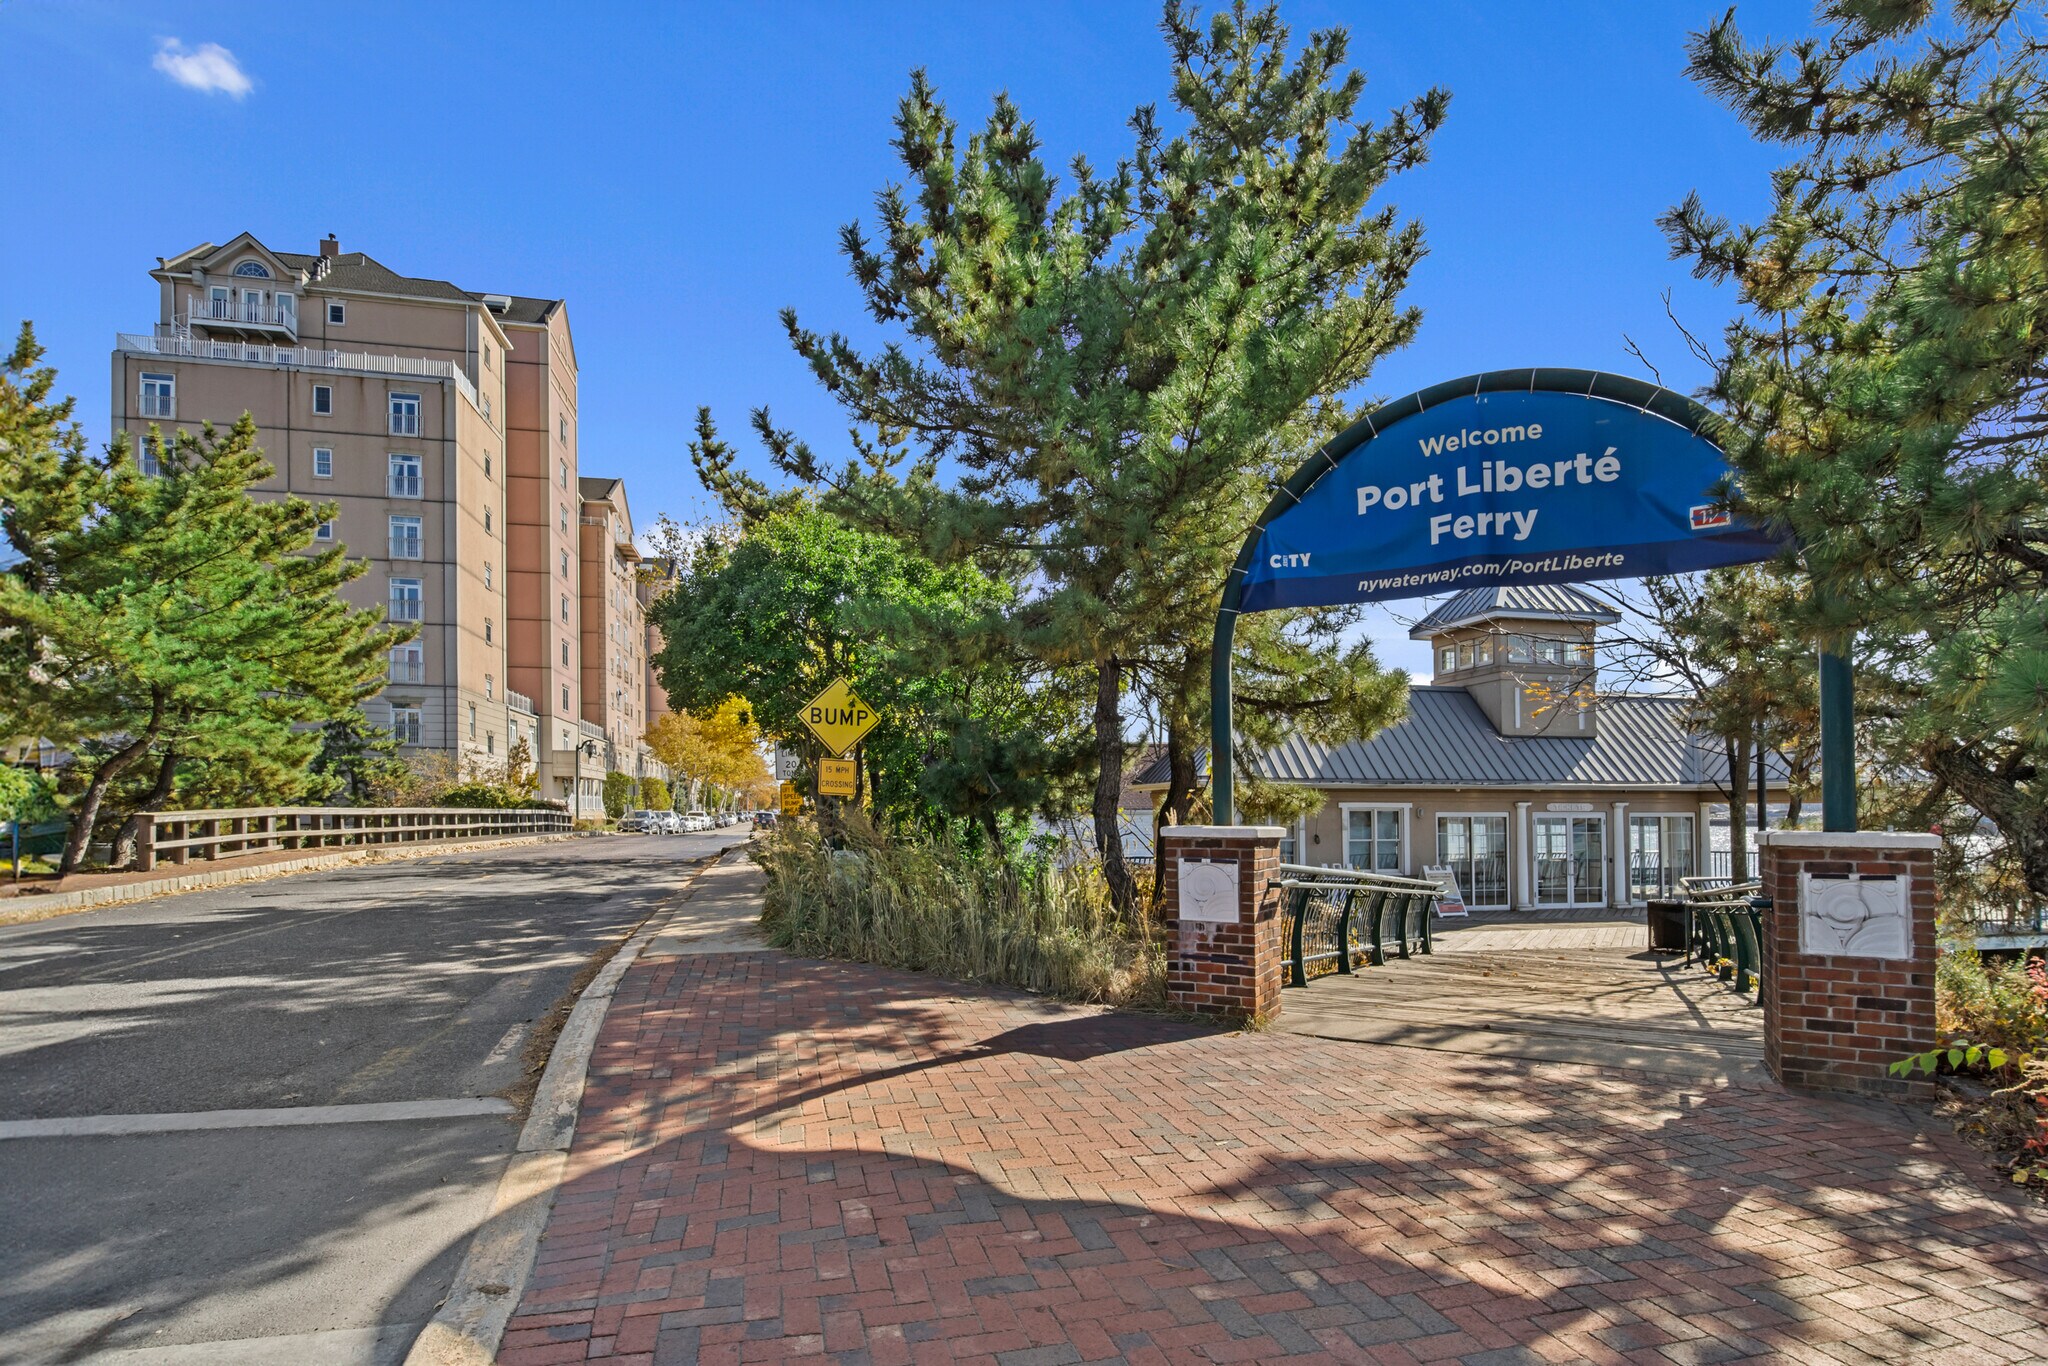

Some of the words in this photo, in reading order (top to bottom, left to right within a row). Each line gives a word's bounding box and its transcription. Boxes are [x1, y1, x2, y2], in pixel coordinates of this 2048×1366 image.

[1419, 423, 1543, 457] Welcome
[1356, 474, 1446, 515] Port
[1457, 446, 1622, 497] Liberté
[1430, 508, 1539, 545] Ferry
[1357, 552, 1625, 592] nywaterway.com/PortLiberte
[810, 707, 869, 726] BUMP
[785, 760, 797, 768] 20
[825, 766, 833, 774] 15
[836, 766, 850, 774] MPH
[821, 780, 853, 788] CROSSING
